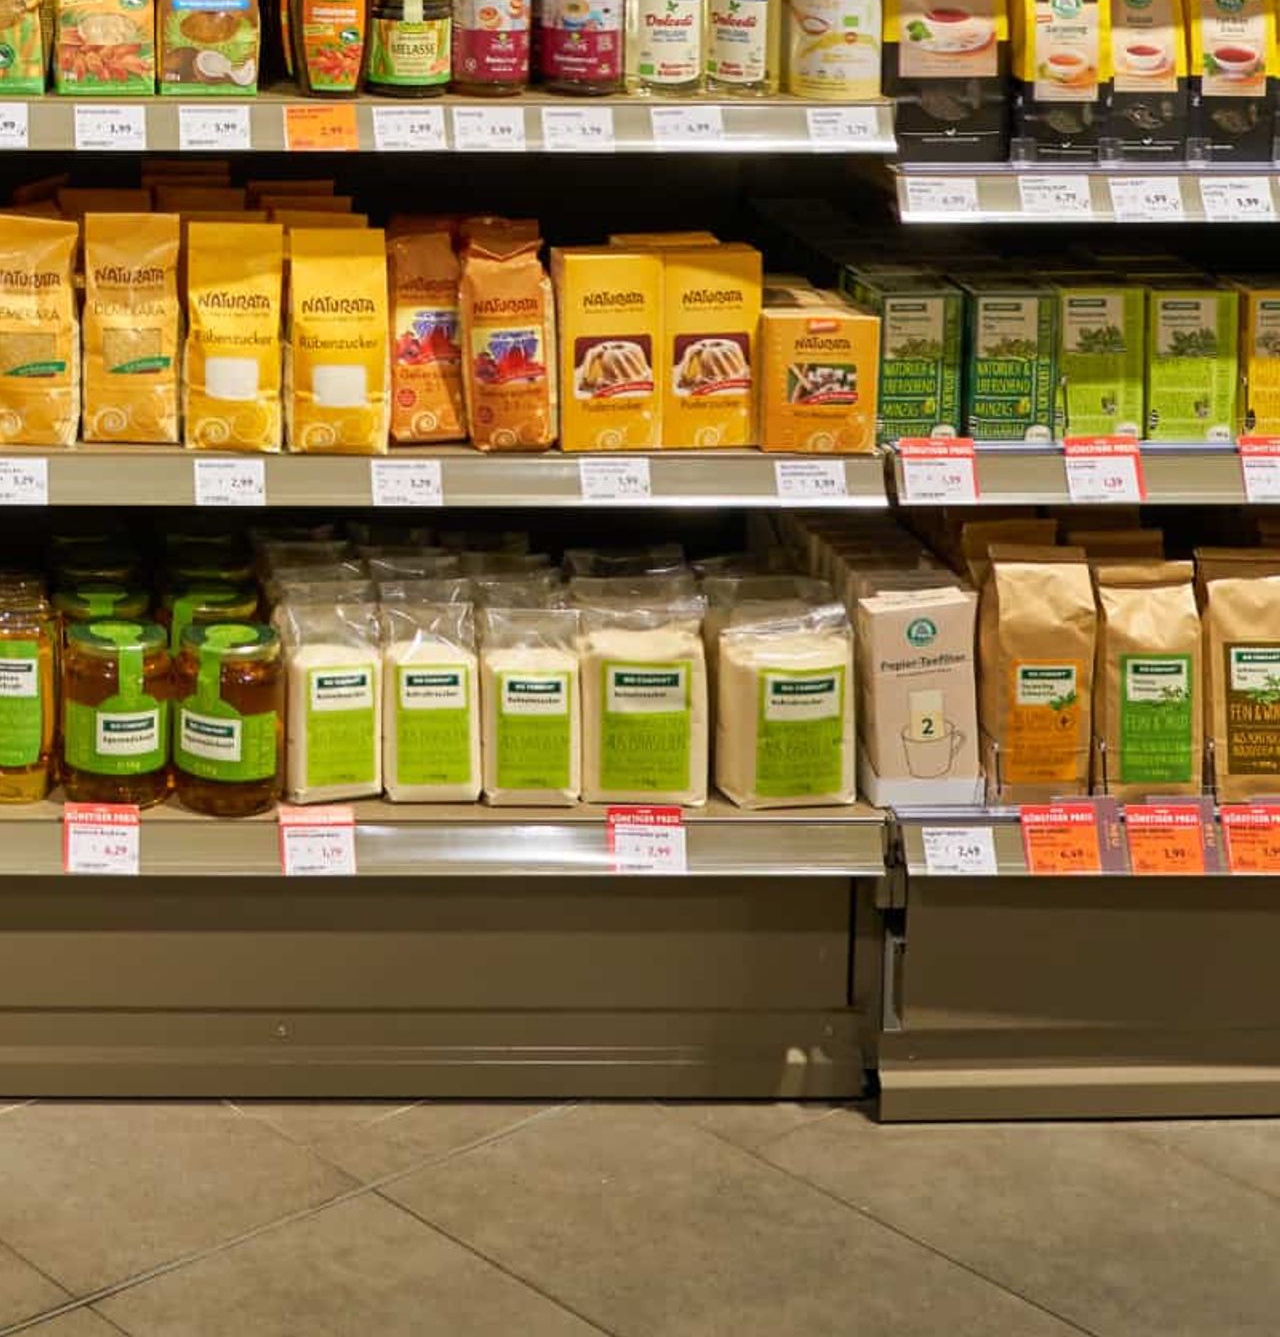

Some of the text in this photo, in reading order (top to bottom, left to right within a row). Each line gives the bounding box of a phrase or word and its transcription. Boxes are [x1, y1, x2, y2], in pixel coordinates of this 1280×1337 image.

[95, 266, 165, 283] NATURATA
[199, 294, 271, 312] NATURATA
[583, 291, 645, 307] NATURATA
[682, 290, 743, 305] NATURATA
[302, 298, 376, 314] NATURATA
[299, 334, 378, 350] Rübenzucker
[795, 337, 851, 351] NATURATA
[921, 718, 935, 735] 2
